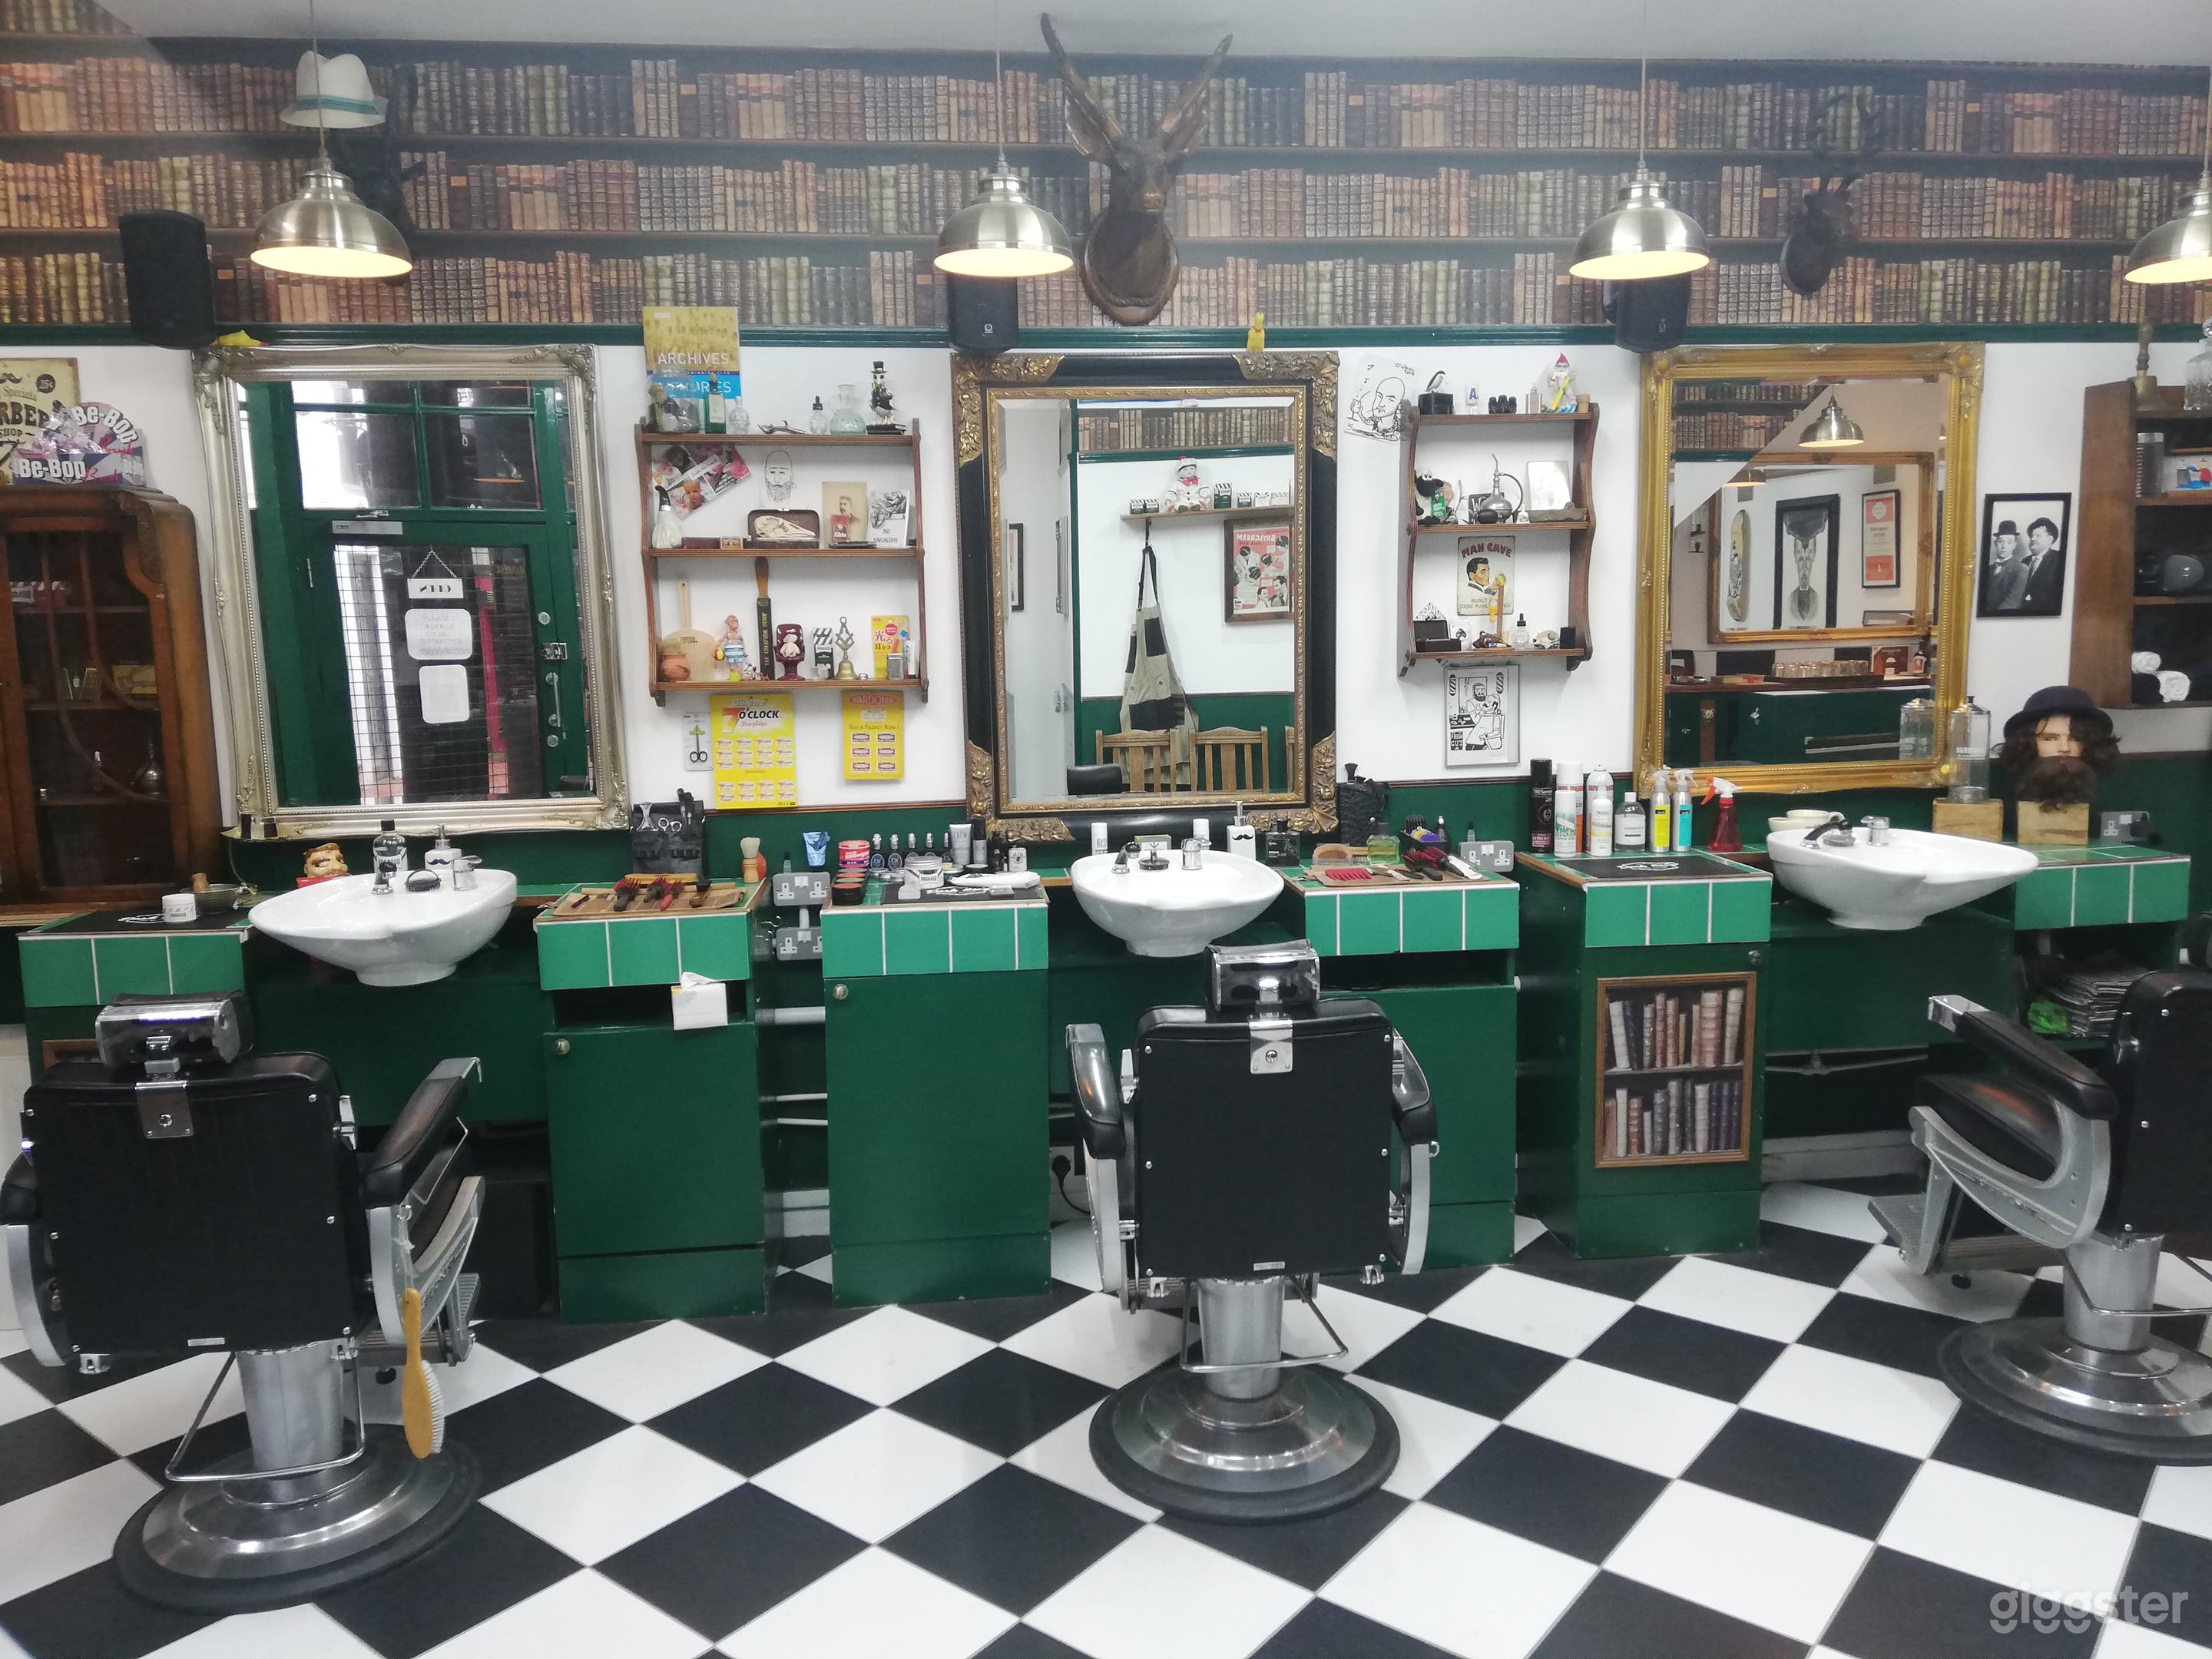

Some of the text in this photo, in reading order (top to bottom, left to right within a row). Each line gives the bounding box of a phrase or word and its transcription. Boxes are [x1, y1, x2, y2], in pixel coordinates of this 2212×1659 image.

[657, 353, 729, 365] ARCHIVES
[1462, 542, 1512, 558] MAN CAVE
